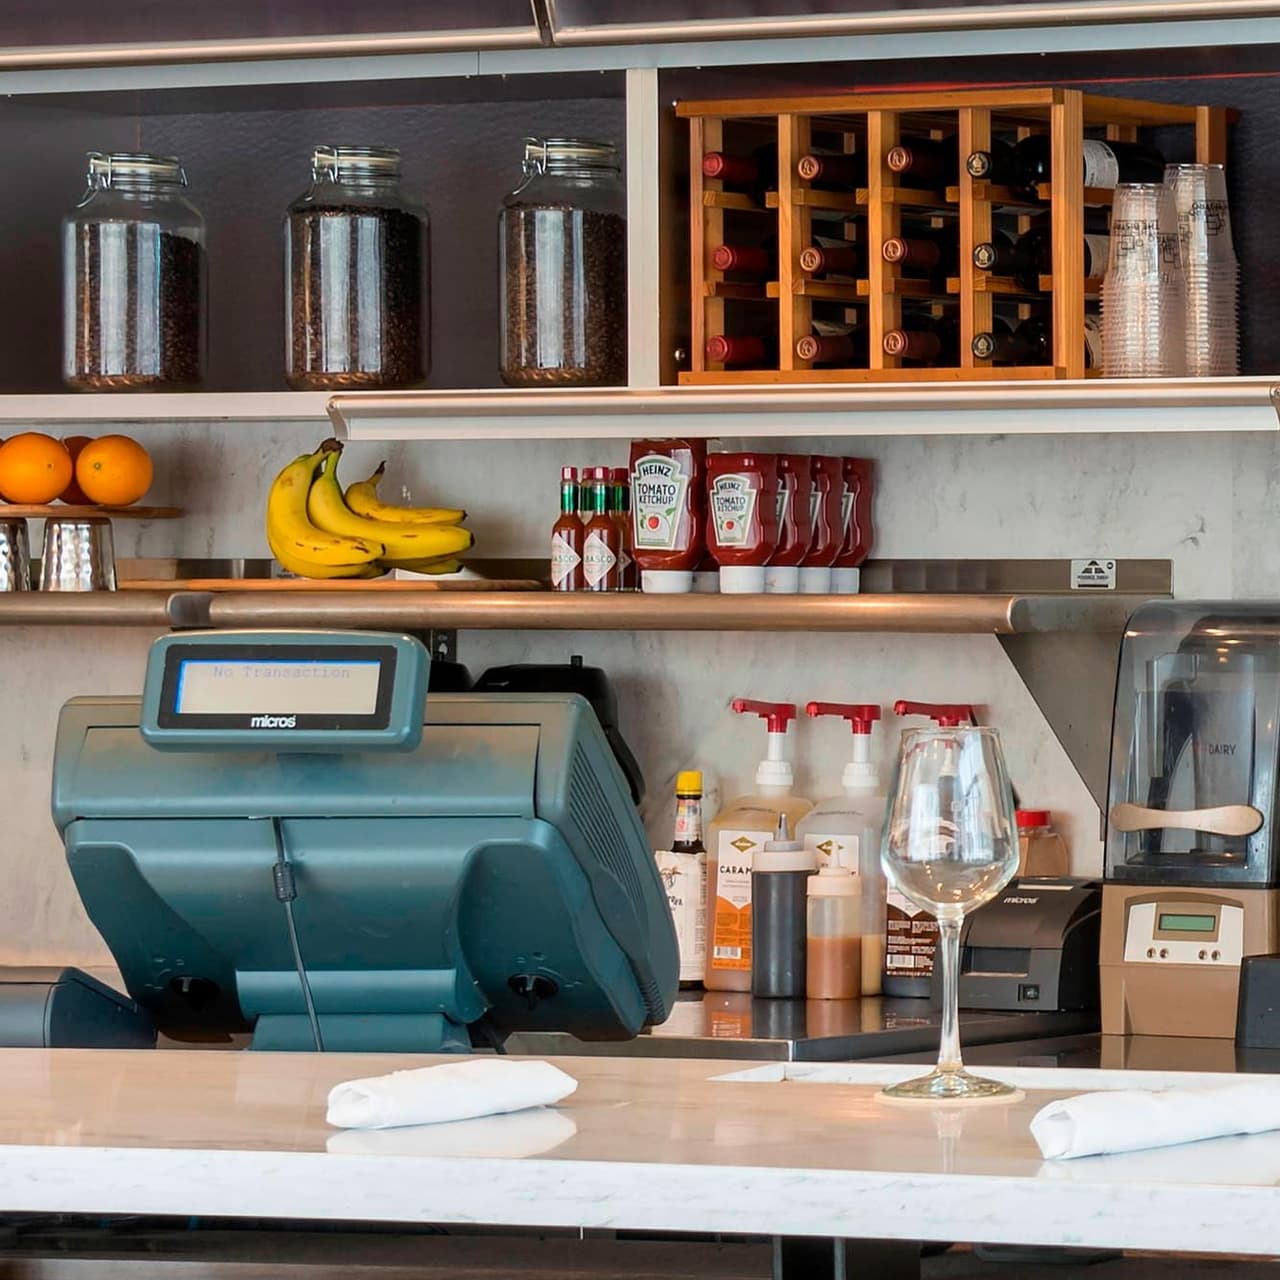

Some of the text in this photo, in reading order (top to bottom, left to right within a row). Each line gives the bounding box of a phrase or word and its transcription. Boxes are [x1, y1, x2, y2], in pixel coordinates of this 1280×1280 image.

[642, 464, 671, 477] HEINZ
[638, 484, 676, 495] TOMATO
[719, 480, 741, 491] HEINZ
[639, 496, 674, 505] KETCHUP
[716, 497, 746, 505] TOMATO
[251, 715, 296, 728] micros
[1208, 743, 1236, 756] DAIRY
